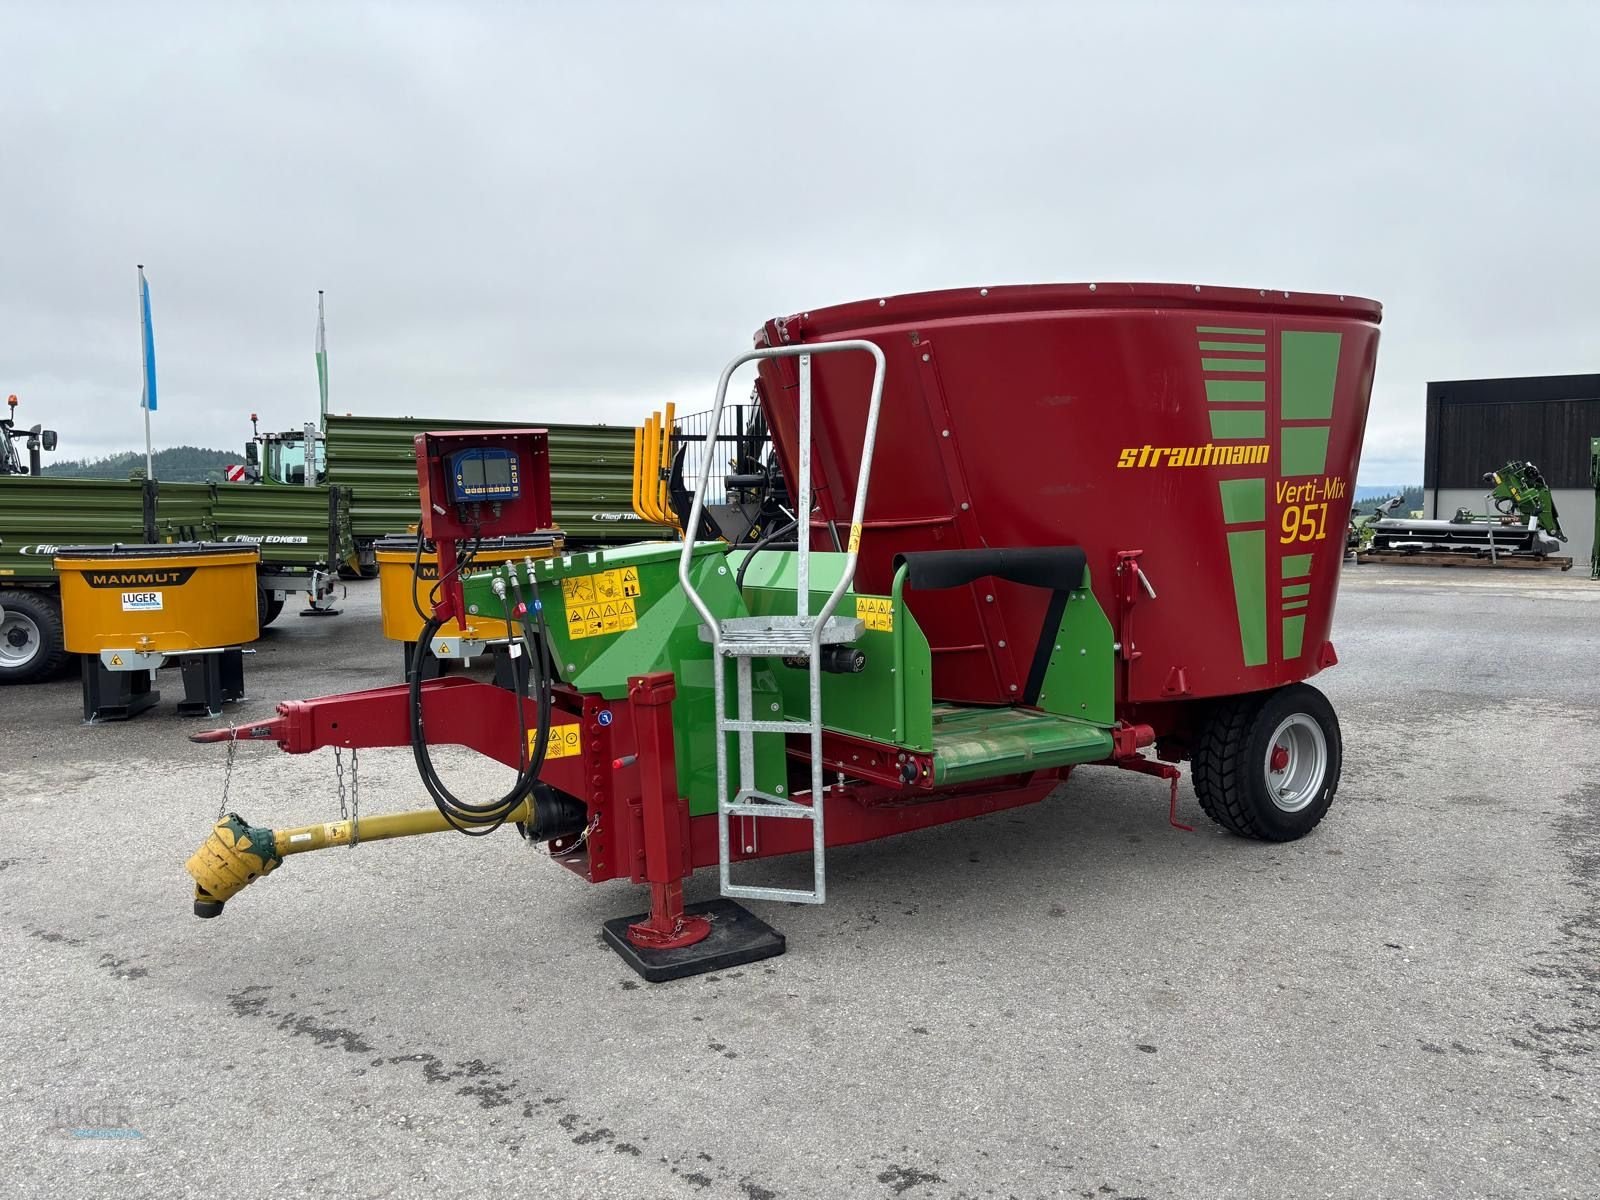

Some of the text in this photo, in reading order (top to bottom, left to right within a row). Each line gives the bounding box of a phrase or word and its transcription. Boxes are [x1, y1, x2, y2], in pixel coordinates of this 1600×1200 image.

[1117, 444, 1270, 467] strautmann
[1276, 477, 1346, 504] Verti-Mix
[1280, 503, 1328, 544] 951
[93, 573, 180, 584] MAMMUT
[123, 593, 157, 603] LUGER
